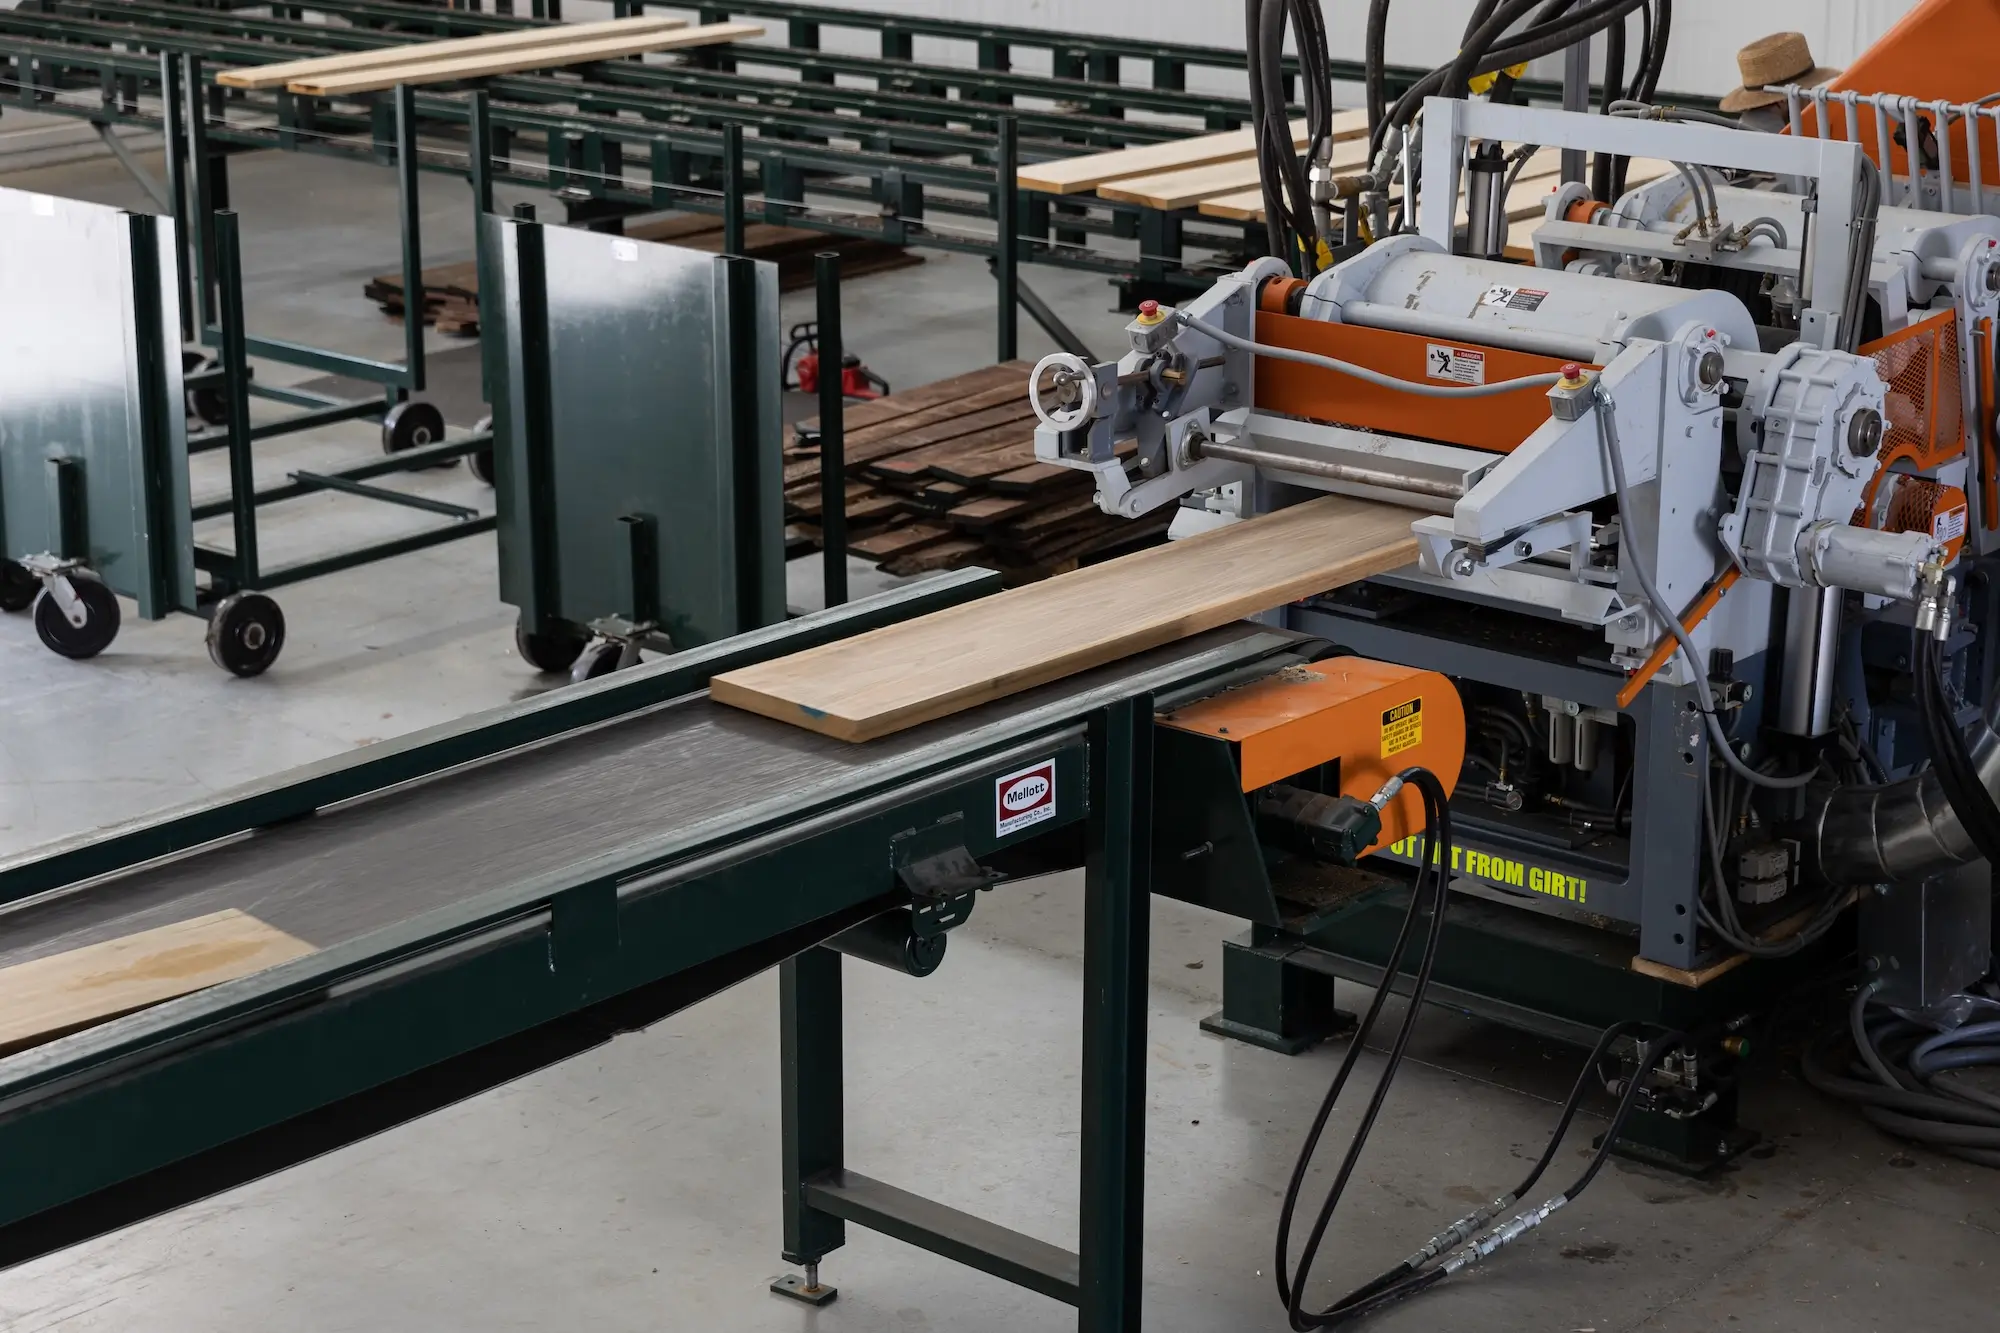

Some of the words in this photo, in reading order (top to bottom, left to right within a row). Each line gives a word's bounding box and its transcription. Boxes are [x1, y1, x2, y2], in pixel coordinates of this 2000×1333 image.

[1460, 352, 1481, 360] DANGER
[1390, 702, 1414, 722] CAUTION
[1007, 783, 1045, 805] Mellott
[1000, 812, 1033, 829] Manufacturing
[1465, 850, 1524, 887] FROM
[1528, 866, 1587, 904] GIRT!
